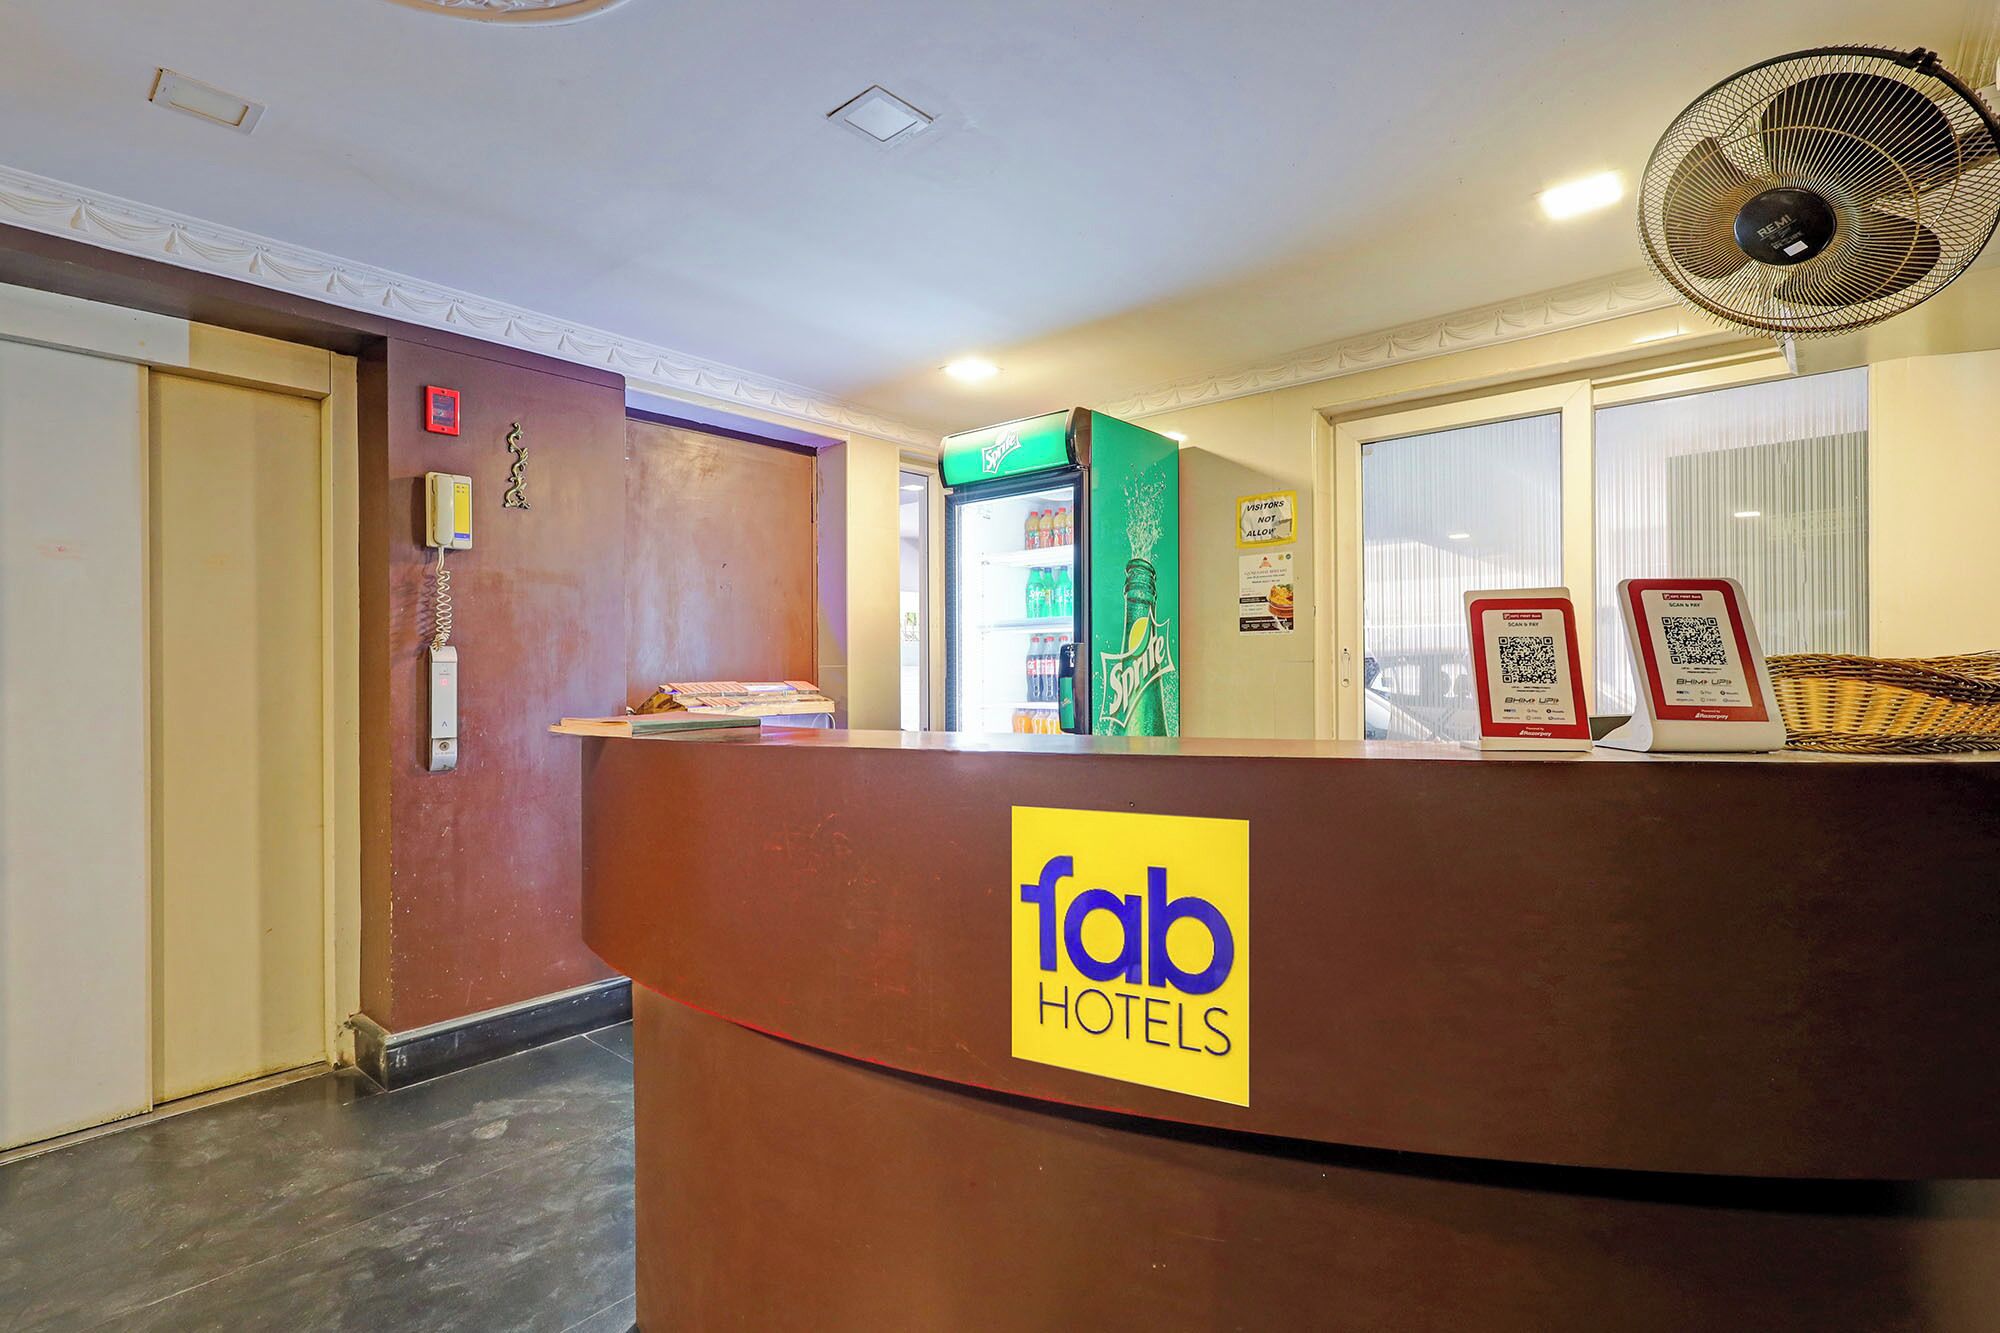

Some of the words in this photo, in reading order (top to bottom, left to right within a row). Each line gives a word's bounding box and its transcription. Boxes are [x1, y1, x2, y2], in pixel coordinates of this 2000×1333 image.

[1757, 214, 1792, 238] REMI
[984, 431, 1018, 471] Sprite
[1246, 501, 1284, 512] VISITORS
[1257, 515, 1276, 523] NOT
[1109, 626, 1166, 716] Sprite
[1020, 855, 1234, 995] fab
[1040, 981, 1231, 1056] HOTELS
